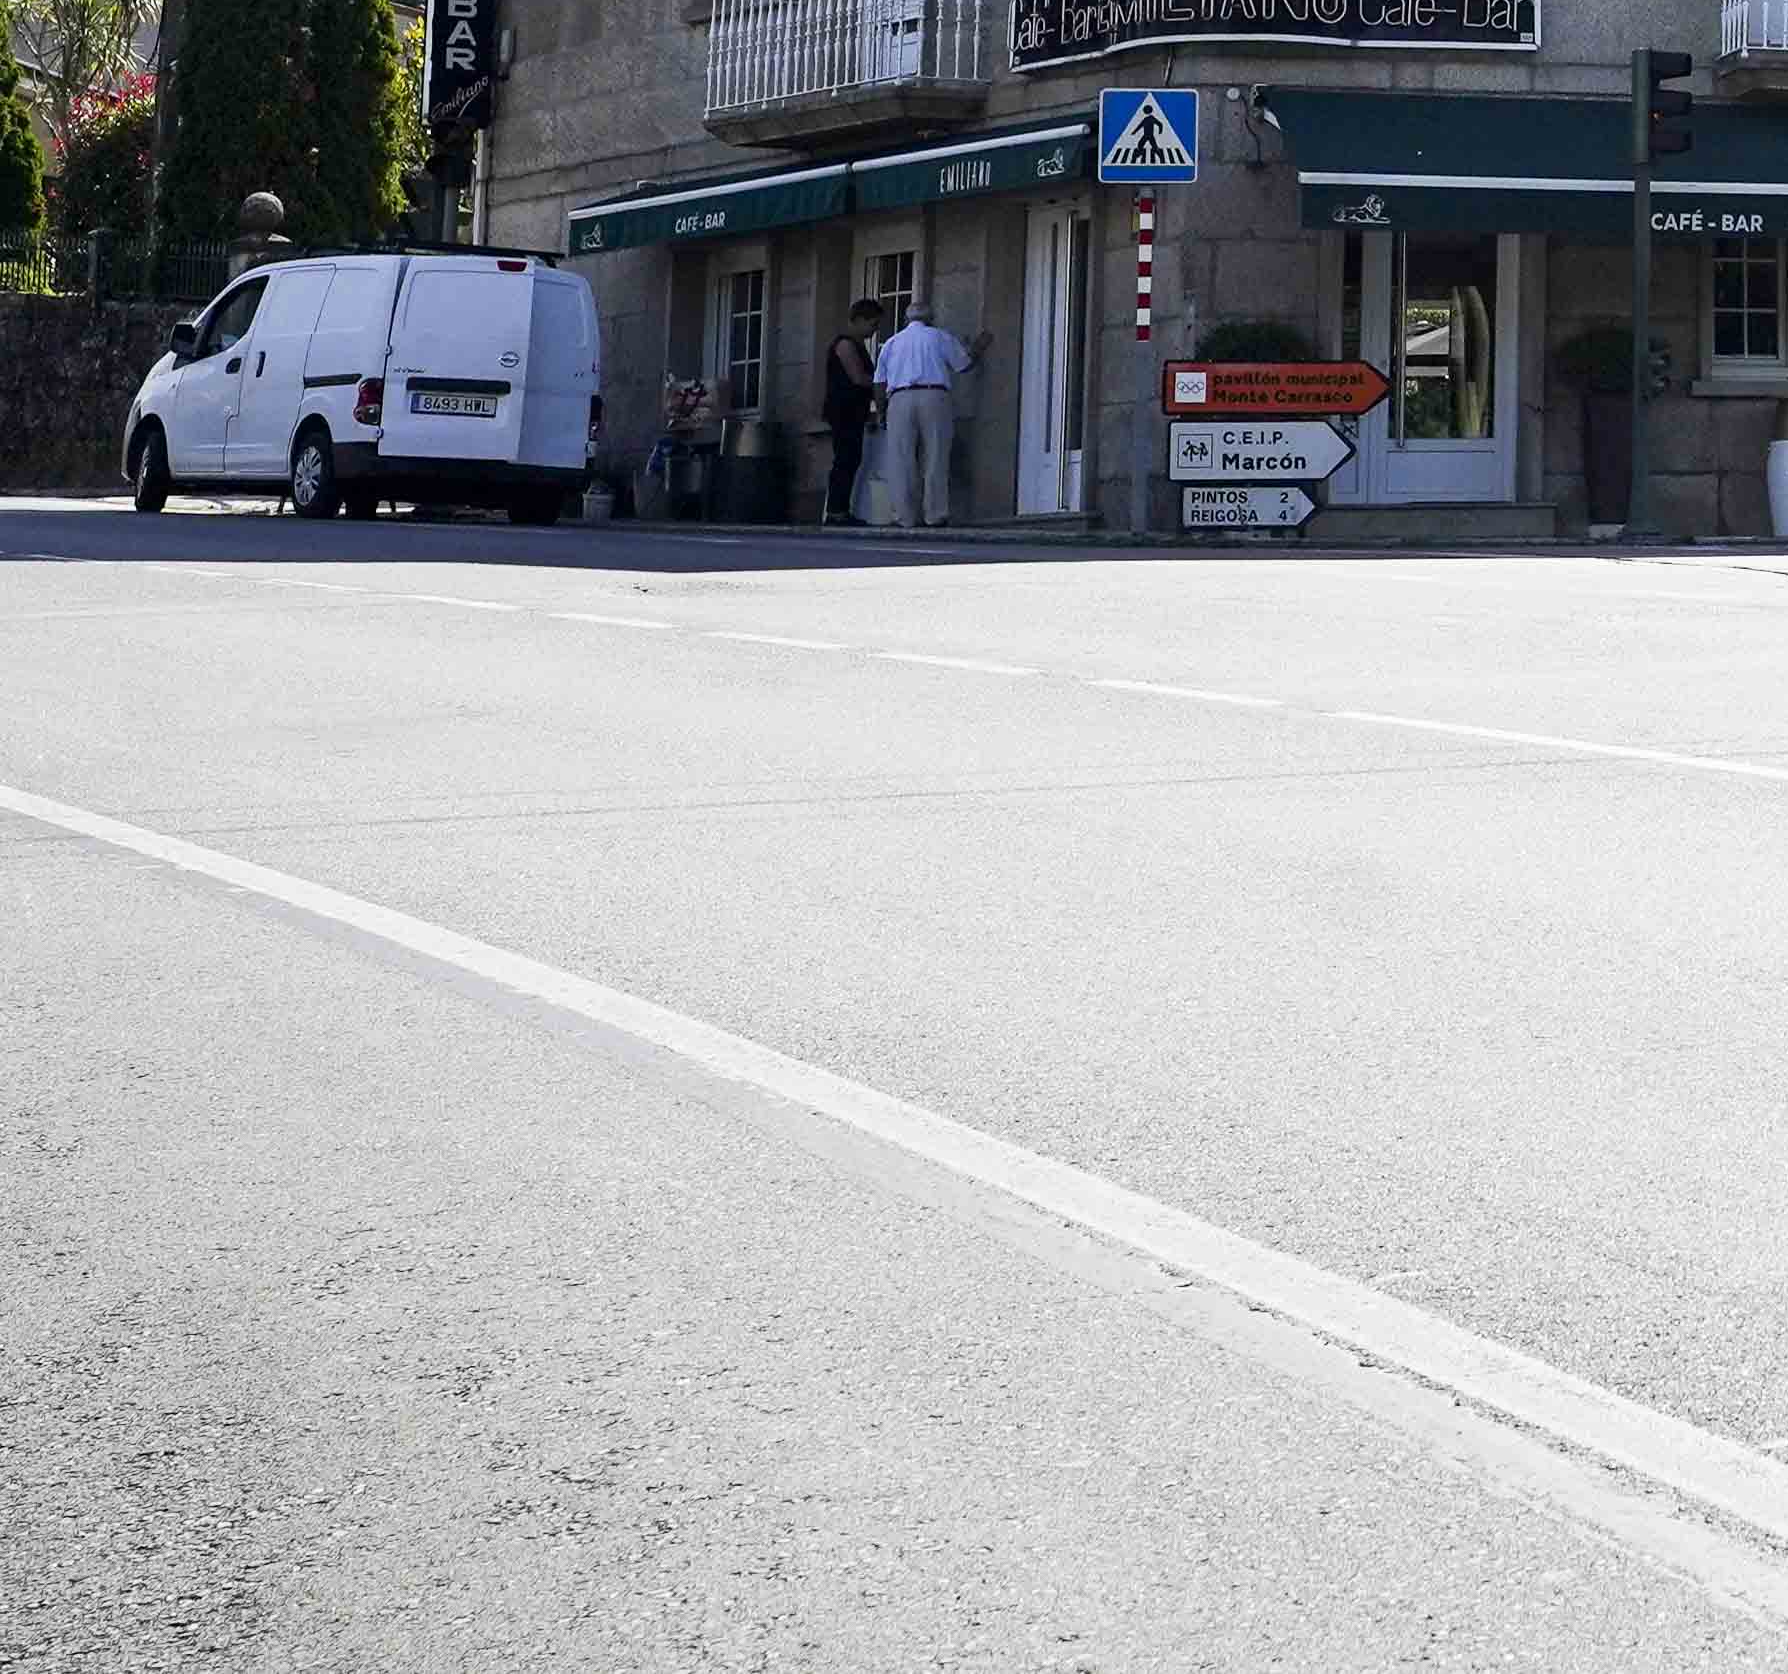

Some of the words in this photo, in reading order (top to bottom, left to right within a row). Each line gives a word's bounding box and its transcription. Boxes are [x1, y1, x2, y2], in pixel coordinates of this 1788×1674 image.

[939, 160, 993, 194] EMILIANO
[1650, 208, 1704, 232] CAFÉ
[1721, 214, 1764, 233] BAR
[1213, 389, 1268, 404] Monte
[1275, 389, 1353, 404] Carrasco
[423, 397, 460, 411] 8493
[1222, 431, 1289, 445] C.E.I.P.
[1222, 452, 1307, 471] Marcón
[1191, 491, 1249, 504] PINTOS
[1279, 491, 1289, 504] 2
[1278, 509, 1288, 522] 4
